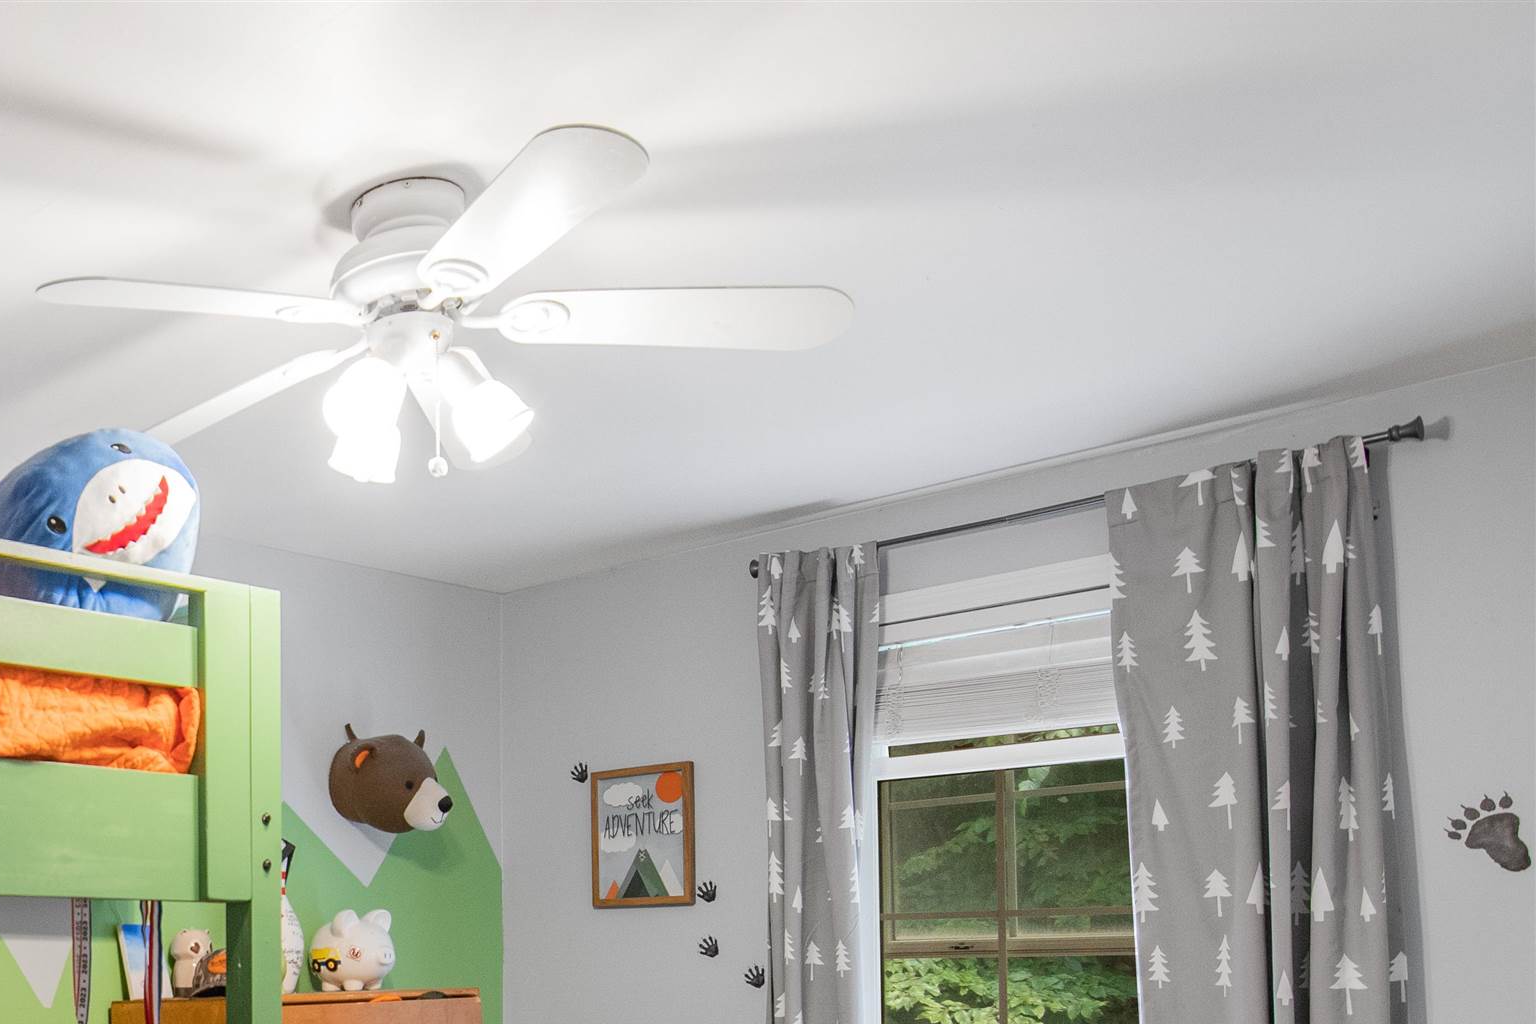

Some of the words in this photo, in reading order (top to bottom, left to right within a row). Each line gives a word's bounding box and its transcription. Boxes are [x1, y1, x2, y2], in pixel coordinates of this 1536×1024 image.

[626, 788, 654, 811] seek
[604, 808, 679, 839] ADVENTURE
[79, 986, 87, 1009] 2023
